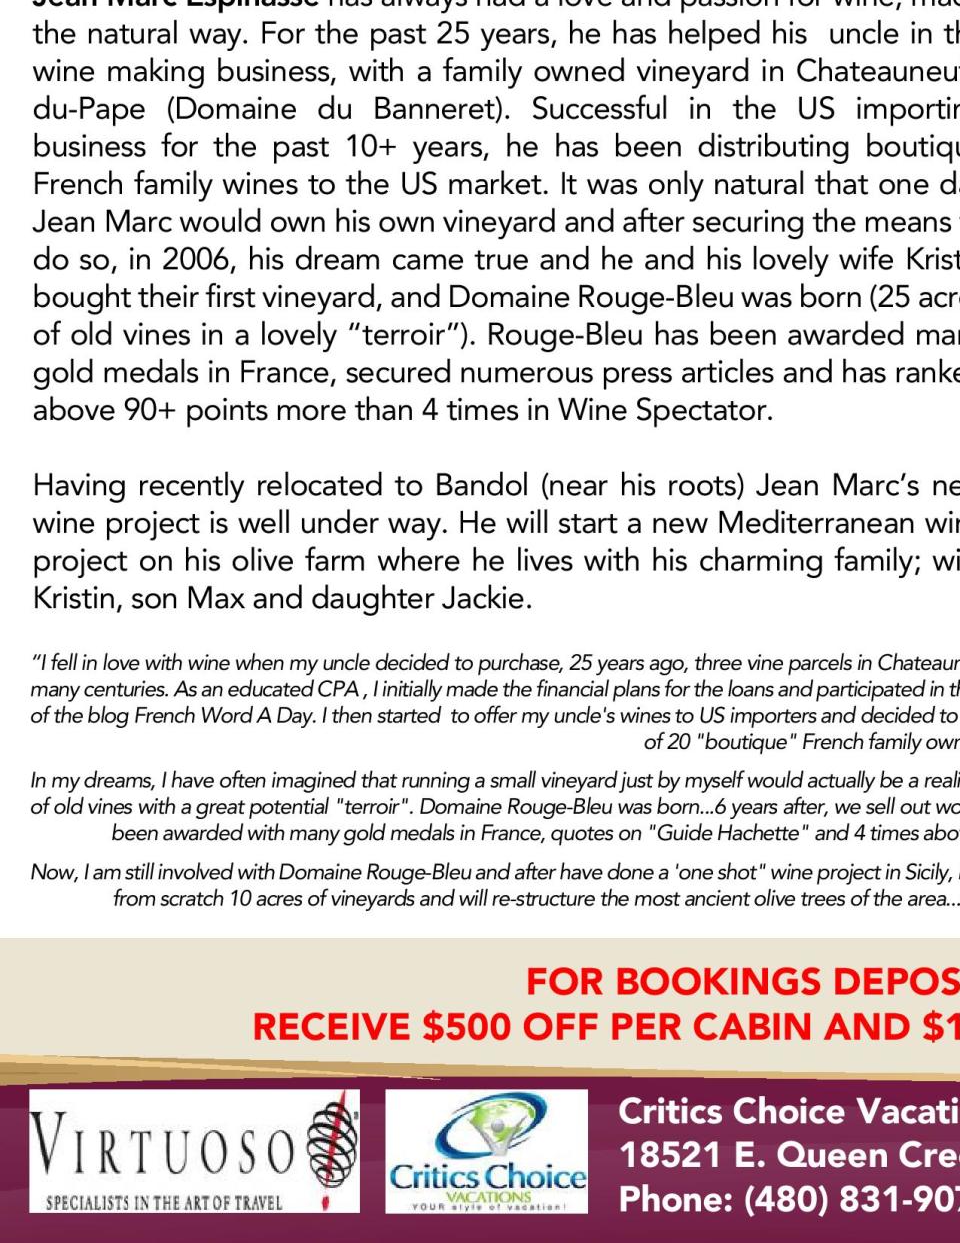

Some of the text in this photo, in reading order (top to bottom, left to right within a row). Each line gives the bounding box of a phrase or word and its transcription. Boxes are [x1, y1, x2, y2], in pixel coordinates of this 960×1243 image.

[33, 395, 773, 428] above 90+ points more than 4 times in Wine Spectator.
[644, 731, 666, 750] of
[666, 732, 691, 750] 20
[697, 731, 797, 755] "boutique"
[802, 731, 864, 750] French
[868, 731, 923, 755] family
[527, 966, 603, 996] FOR
[617, 966, 821, 996] BOOKINGS
[254, 1012, 410, 1041] RECEIVE
[423, 1009, 511, 1044] $500
[523, 1012, 598, 1041] OFF
[611, 1012, 681, 1041] PER
[693, 1012, 811, 1041] CABIN
[824, 1012, 911, 1041] AND
[618, 1096, 723, 1125] Critics
[733, 1095, 845, 1125] Choice
[30, 1111, 295, 1175] VIRTUOSO
[620, 1140, 718, 1168] 18521
[735, 1141, 766, 1168] E.
[777, 1140, 888, 1168] Queen
[390, 1161, 587, 1189] Critics Choice
[46, 1195, 283, 1211] SPECIALISTS IN THE ART OF TRAVEL
[412, 1203, 445, 1211] YOUR
[446, 1191, 532, 1203] VACATIONS
[620, 1183, 732, 1213] Phone:
[745, 1184, 828, 1217] (480)
